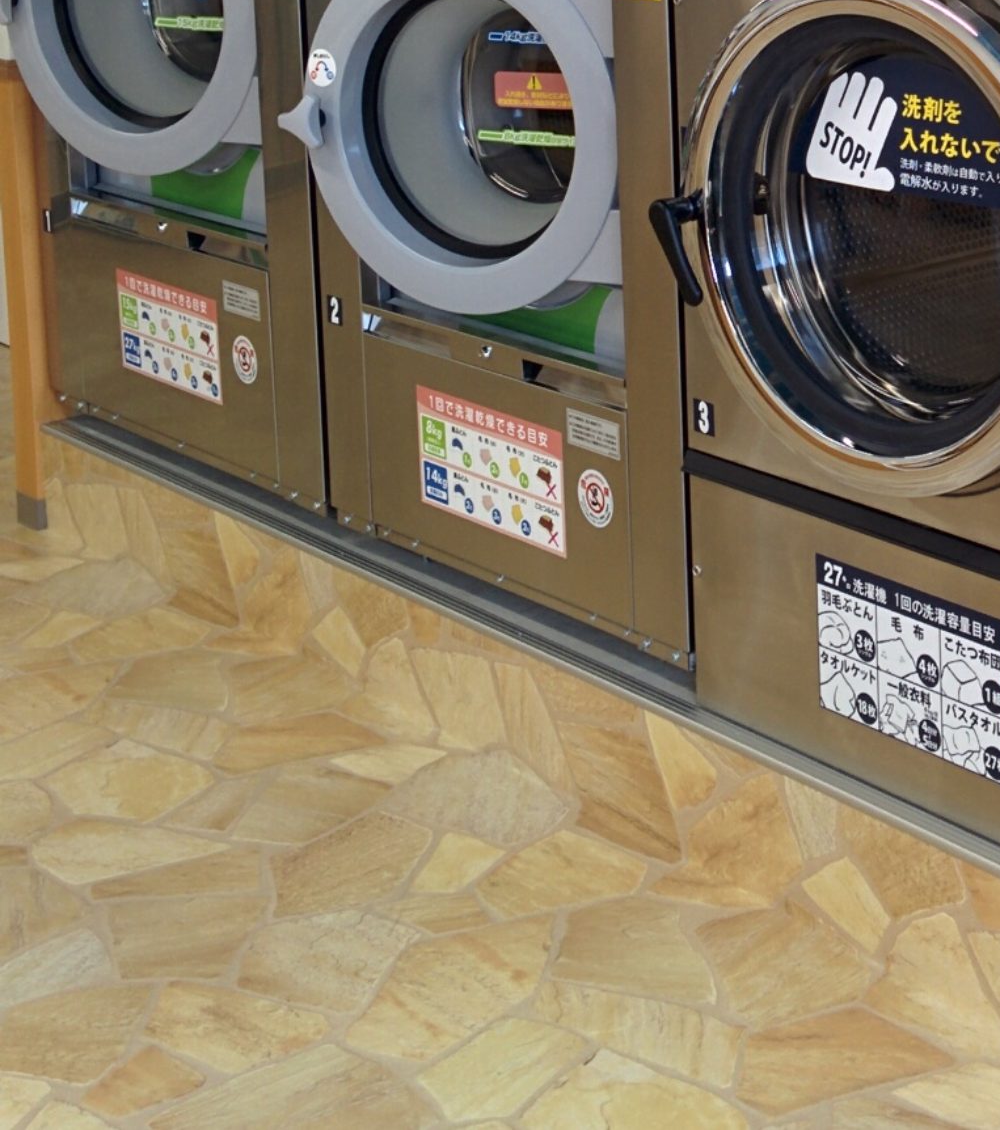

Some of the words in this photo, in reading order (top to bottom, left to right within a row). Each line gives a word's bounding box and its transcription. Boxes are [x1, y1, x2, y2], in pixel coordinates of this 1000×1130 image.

[902, 93, 962, 124] 洗剤を
[819, 120, 872, 179] STOP!
[900, 173, 983, 198] 電解水が入ります。
[330, 297, 339, 324] 2
[425, 420, 442, 440] 8kg
[428, 394, 548, 448] 1回で洗濯乾燥できる目安
[698, 400, 709, 434] 3
[426, 466, 448, 490] 14kg
[894, 592, 996, 644] 1回の洗濯容量目安
[855, 634, 874, 652] 3枚
[820, 652, 876, 685] タオルケット
[918, 659, 937, 677] 4枚
[886, 681, 932, 706] 一般衣料
[857, 699, 876, 717] 18枚
